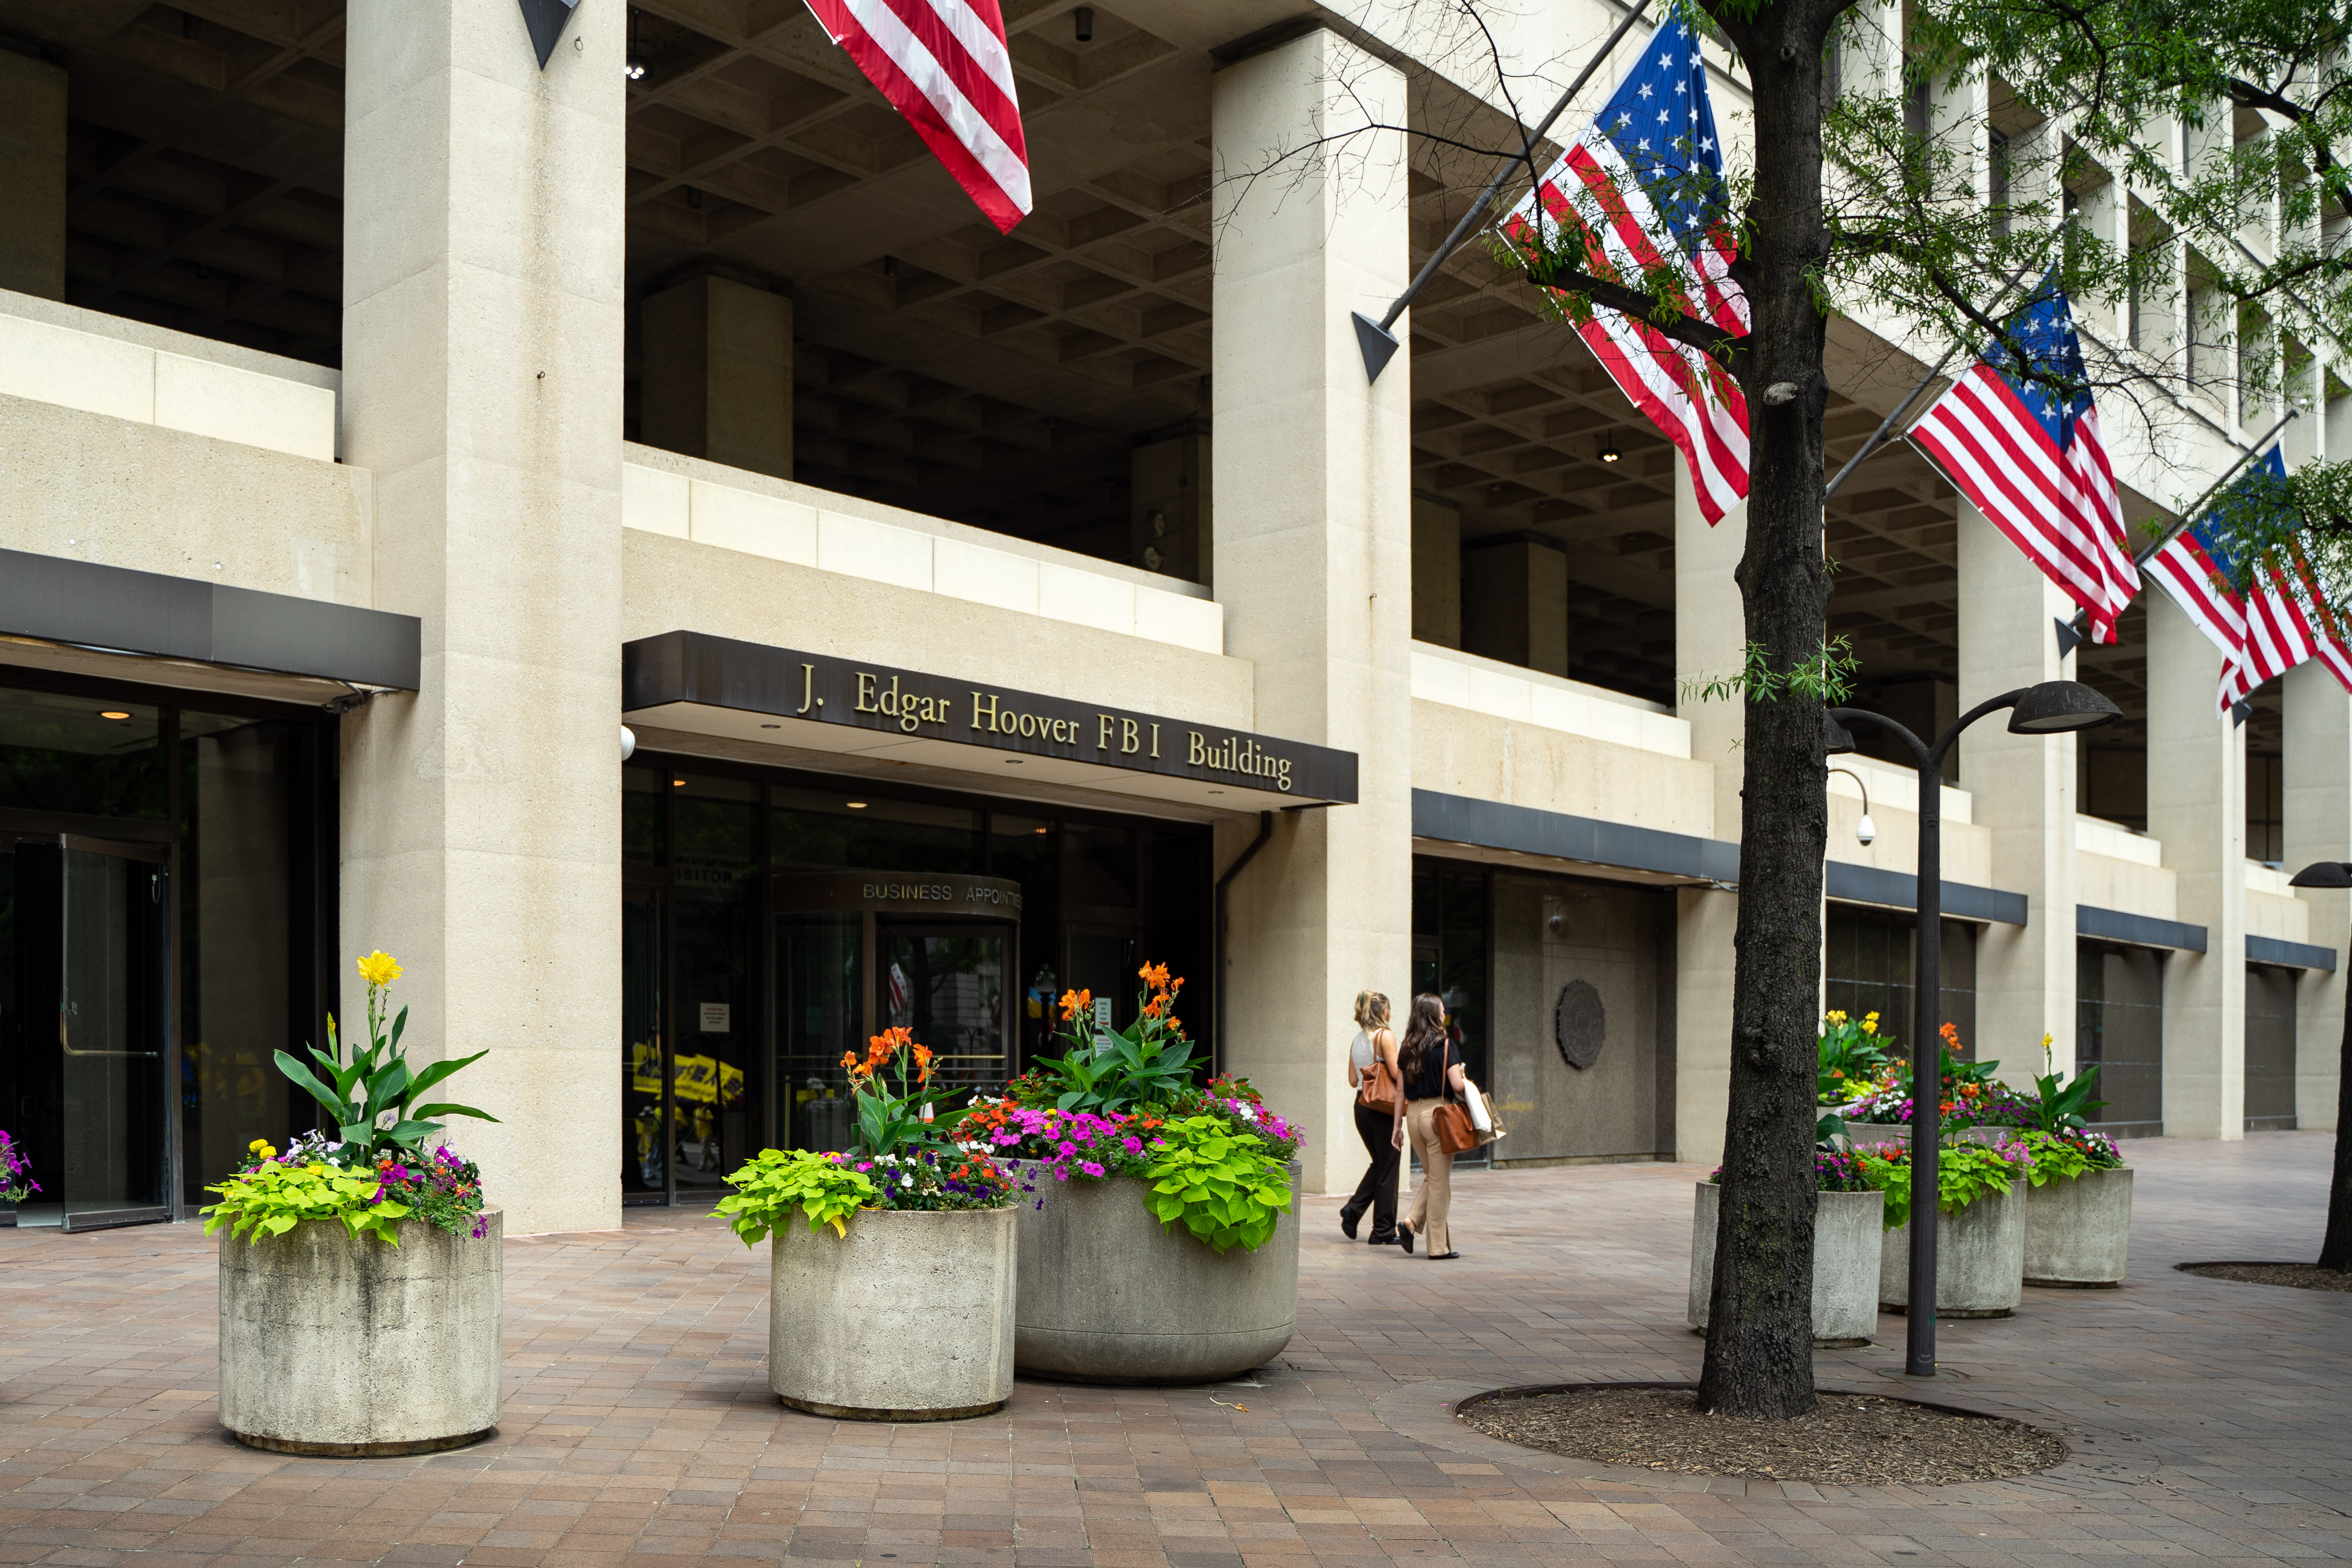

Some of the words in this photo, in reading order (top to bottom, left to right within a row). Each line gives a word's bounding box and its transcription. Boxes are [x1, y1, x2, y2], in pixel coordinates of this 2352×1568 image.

[796, 663, 824, 713] J.
[854, 672, 950, 732] Edgar
[970, 691, 1080, 744] Hoover
[1187, 731, 1292, 791] Building
[623, 850, 651, 861] FEDER
[705, 858, 717, 867] OF
[719, 859, 749, 870] INVEST
[677, 867, 733, 883] ISITOR
[863, 883, 952, 900] BUSINESS
[965, 887, 1023, 908] APPOINTME
